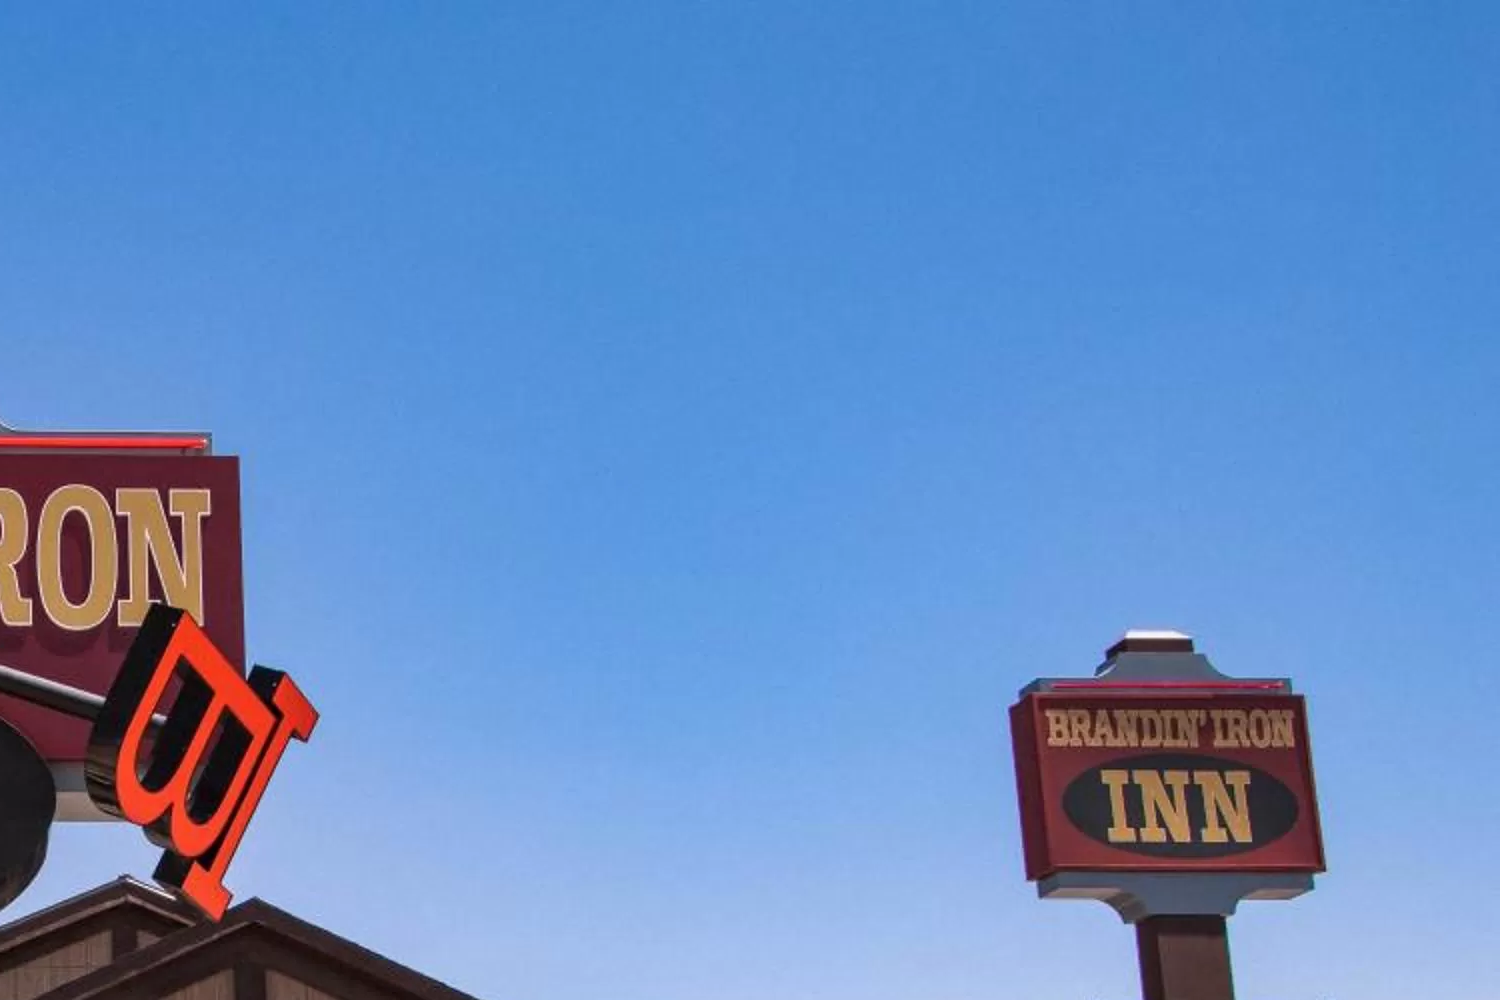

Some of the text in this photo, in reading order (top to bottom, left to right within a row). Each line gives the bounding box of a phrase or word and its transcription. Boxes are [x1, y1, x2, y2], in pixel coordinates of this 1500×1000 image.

[1045, 708, 1295, 749] BRANDIN' IRON
[1101, 769, 1253, 843] INN
